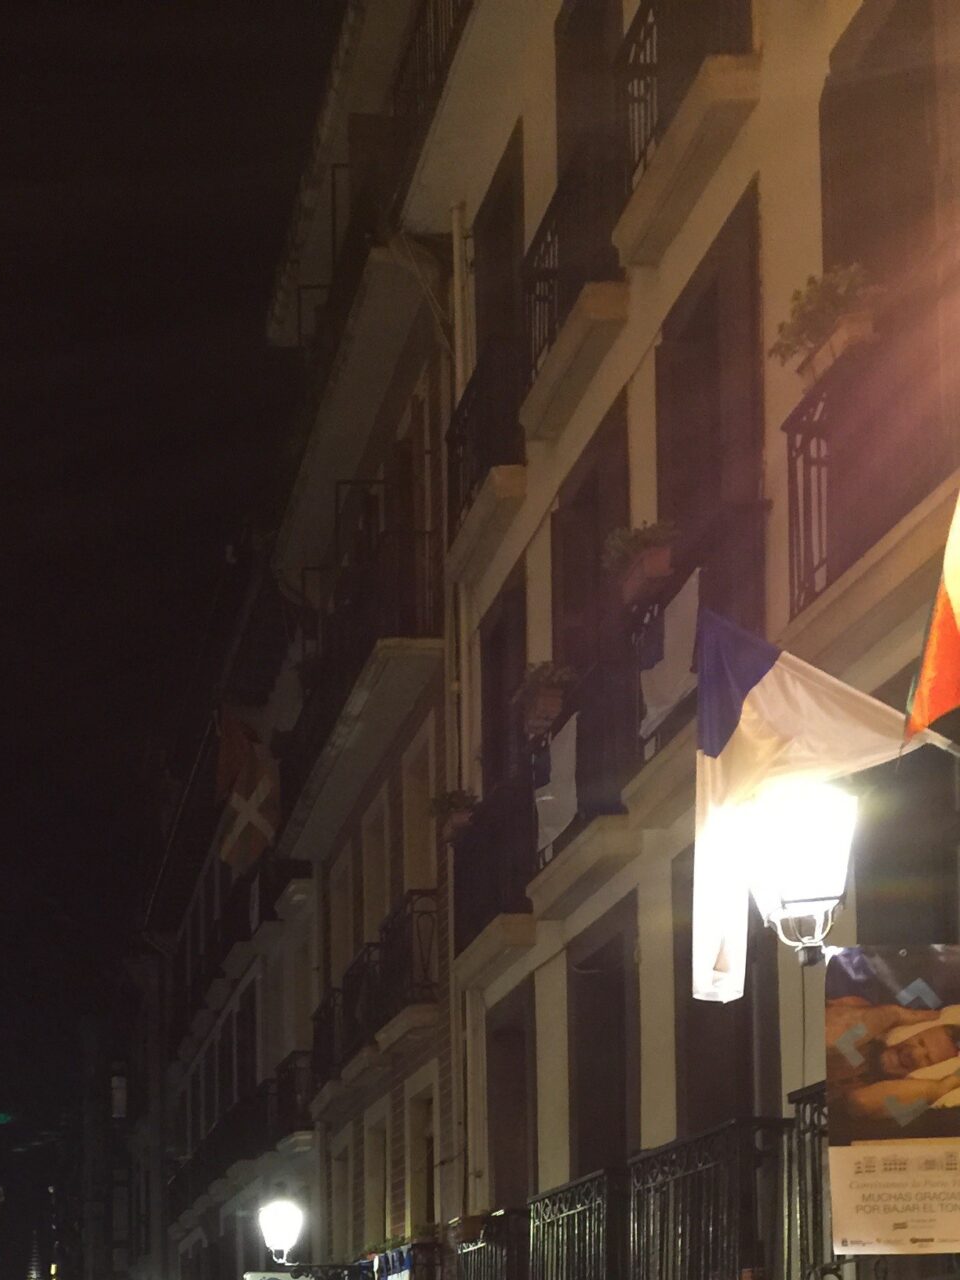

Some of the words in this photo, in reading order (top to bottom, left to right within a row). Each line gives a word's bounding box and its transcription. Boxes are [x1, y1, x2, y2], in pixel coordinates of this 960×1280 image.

[862, 1192, 912, 1202] MUCHAS
[856, 1204, 880, 1214] POR
[883, 1204, 919, 1213] BAJAR
[923, 1203, 936, 1212] EL
